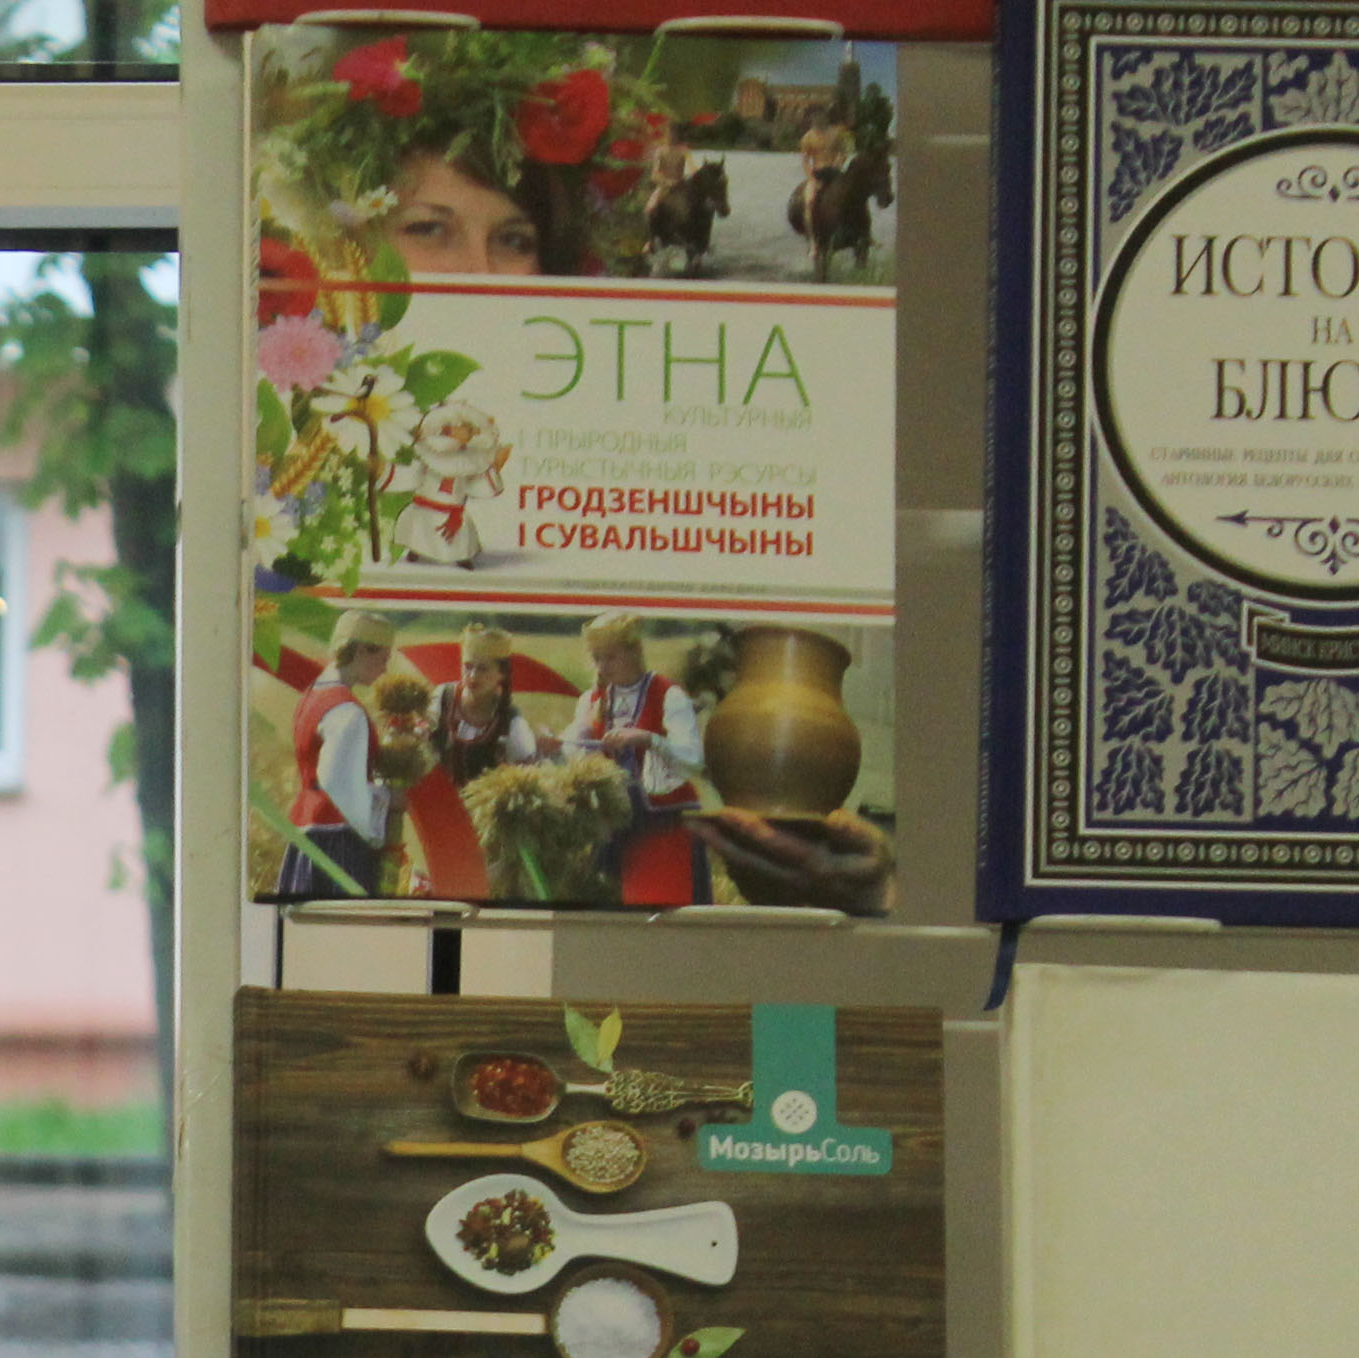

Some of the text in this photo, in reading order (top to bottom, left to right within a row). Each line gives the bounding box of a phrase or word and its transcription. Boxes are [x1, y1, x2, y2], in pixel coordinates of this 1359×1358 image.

[1311, 315, 1354, 345] НА
[521, 316, 812, 407] ЭТНА
[518, 484, 814, 519] ГРОДЗЕНШЧЫНЫ
[535, 522, 814, 556] СУВАЛЬШЧЫНЫ
[709, 1134, 881, 1168] МозырьСоль
